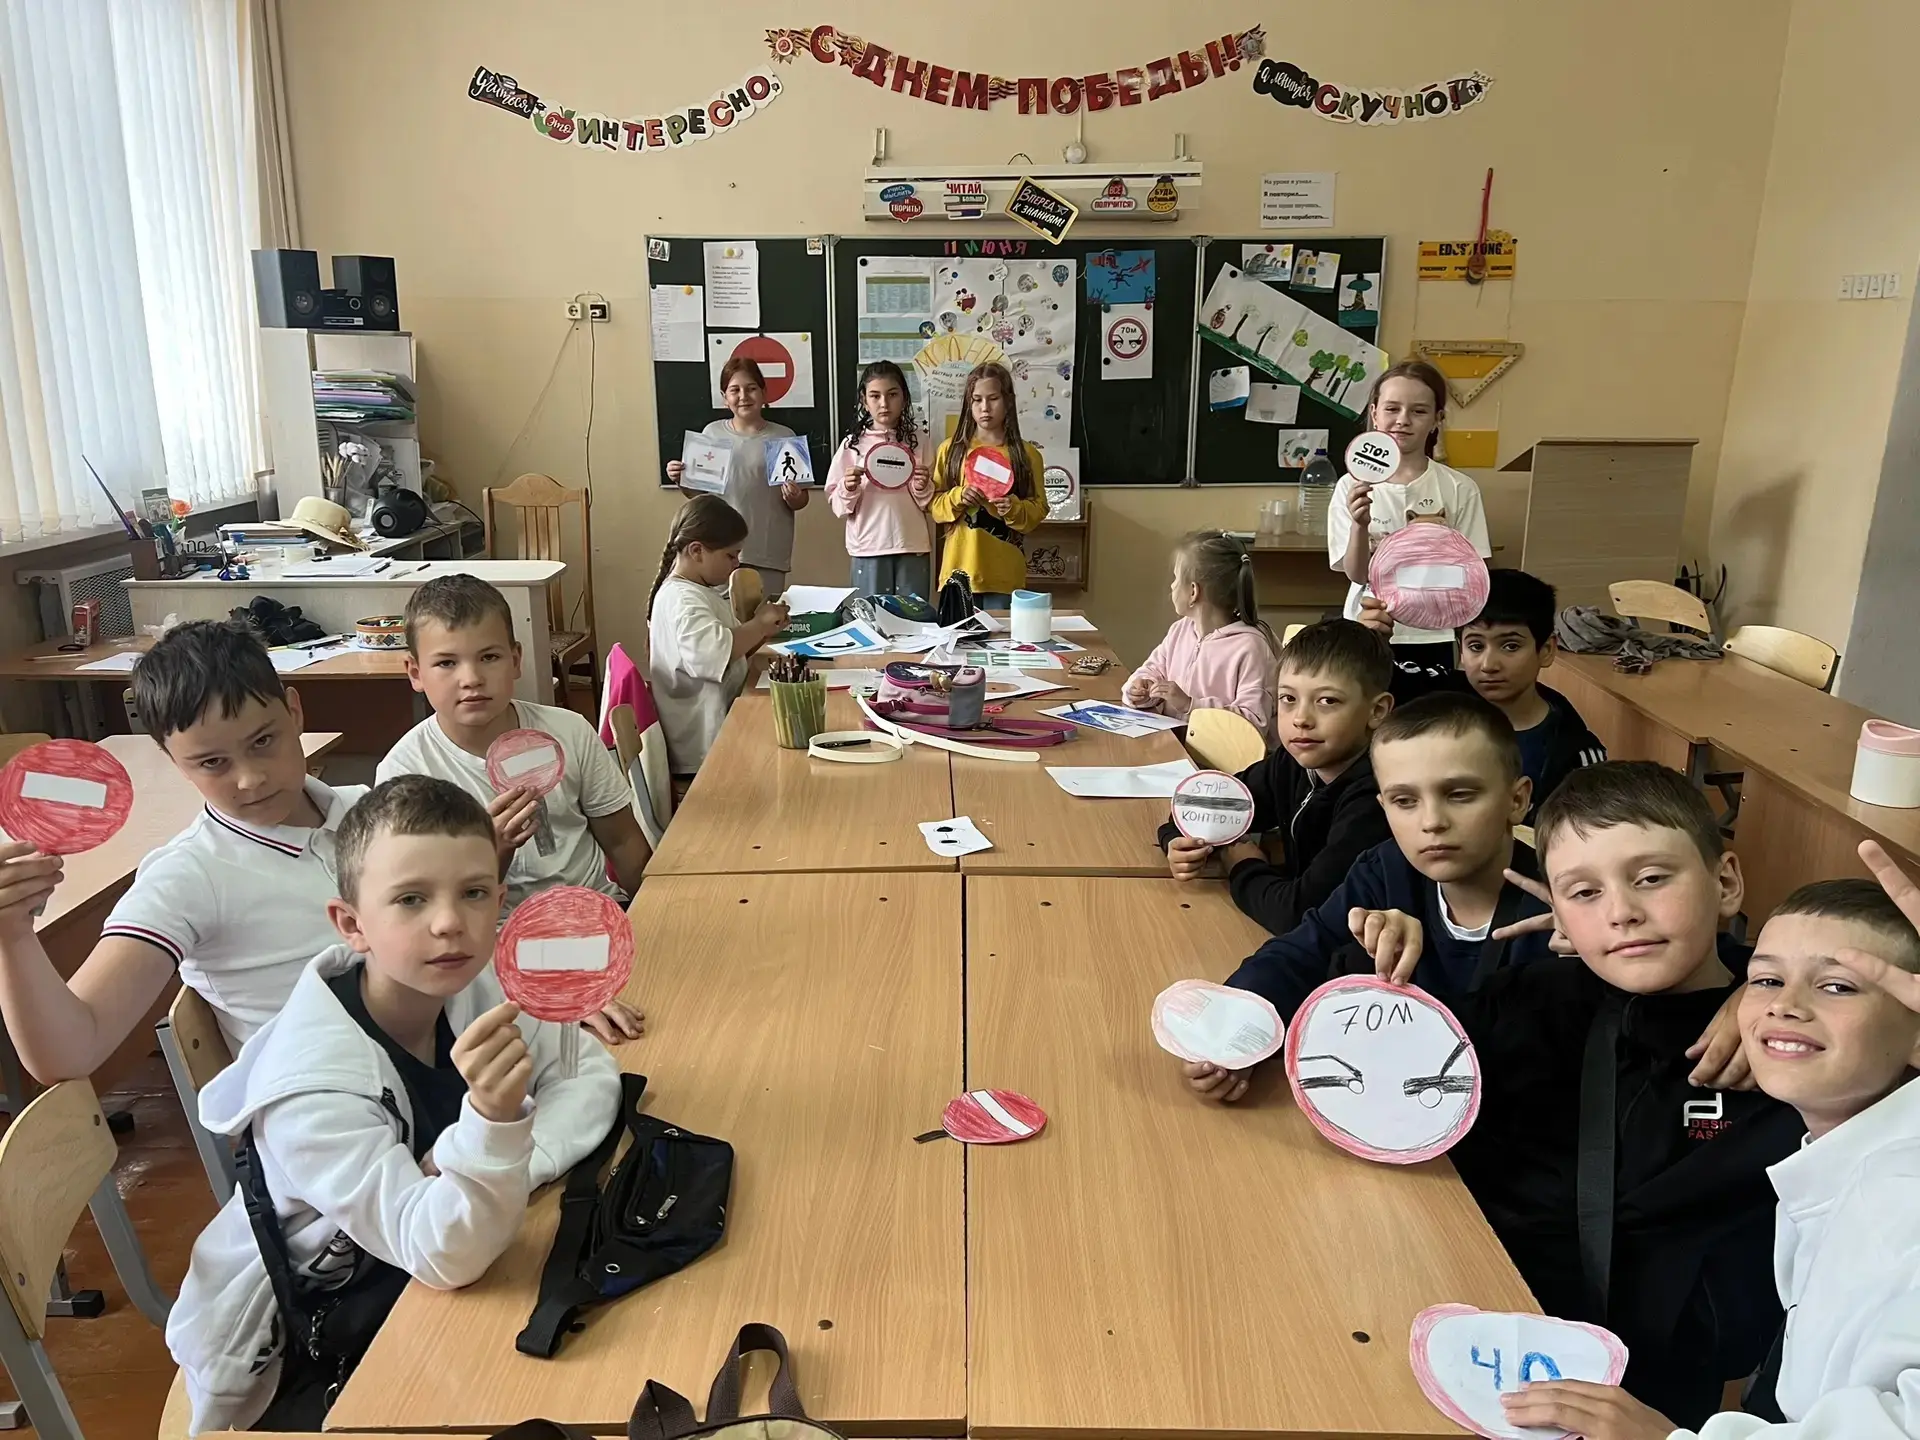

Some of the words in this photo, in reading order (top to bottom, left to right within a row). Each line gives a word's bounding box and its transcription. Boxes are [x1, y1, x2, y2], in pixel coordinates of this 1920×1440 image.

[810, 25, 835, 63] С
[852, 42, 989, 111] ДНЕМ
[1017, 33, 1241, 115] ПОБЕДЫ!
[946, 182, 982, 194] ЧИТАЙ
[1154, 188, 1174, 196] БУДЬ
[891, 204, 920, 212] ТВОРИТЬ!
[1012, 203, 1021, 212] К
[1021, 205, 1066, 228] ЗНАНИЯМ!
[965, 239, 1027, 255] ИЮНЯ
[1361, 442, 1390, 459] STOP
[1045, 477, 1065, 485] STOP
[1191, 780, 1229, 795] STOP
